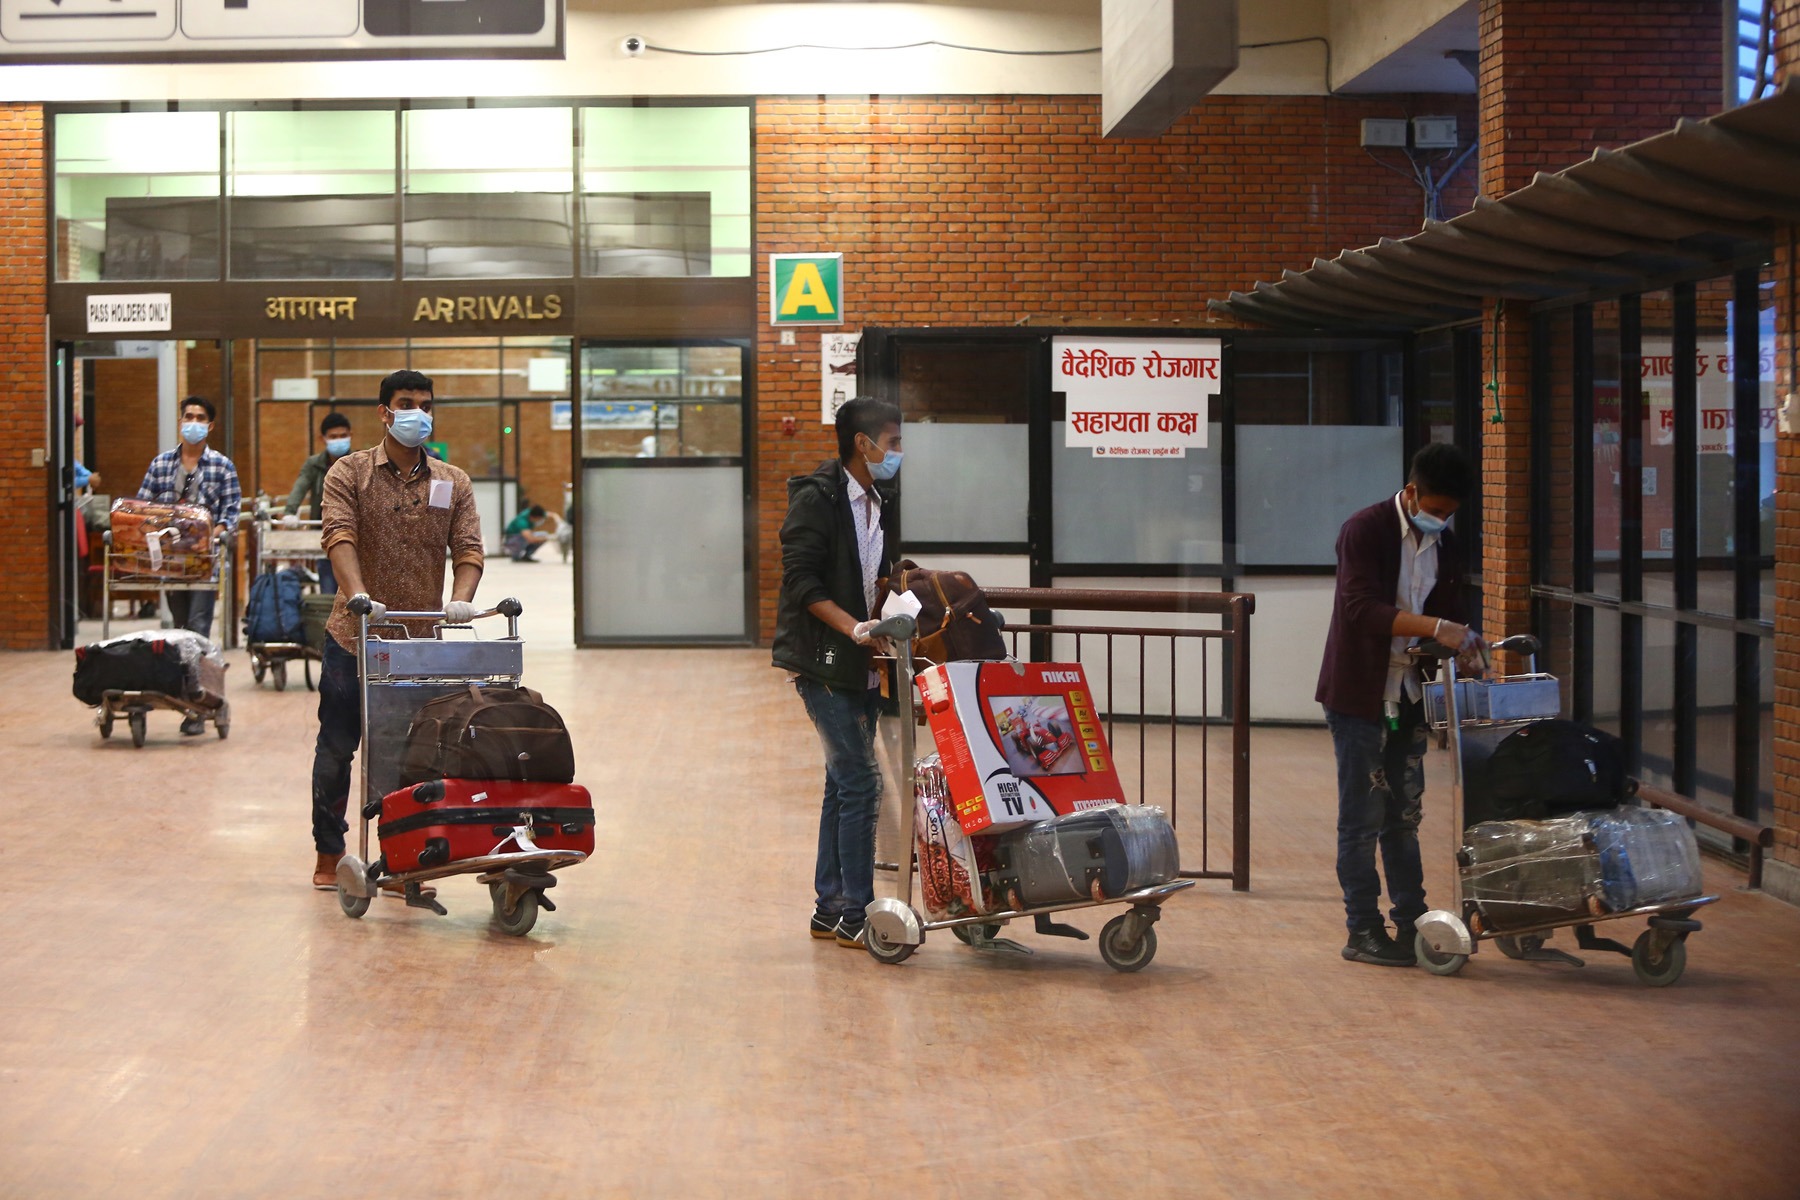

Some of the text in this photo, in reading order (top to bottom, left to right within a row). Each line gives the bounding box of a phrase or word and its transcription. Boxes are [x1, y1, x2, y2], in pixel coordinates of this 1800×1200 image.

[780, 263, 834, 314] A
[90, 302, 170, 322] PASS HOLDERS ONLY
[265, 297, 357, 320] आगमन
[413, 294, 562, 322] ARRIVALS
[1062, 348, 1220, 379] वैदेशिक रोजगार
[1072, 412, 1199, 435] सहायता कक्ष
[1041, 671, 1080, 683] NIKAI
[997, 782, 1019, 793] HIGH
[1002, 797, 1024, 815] TV
